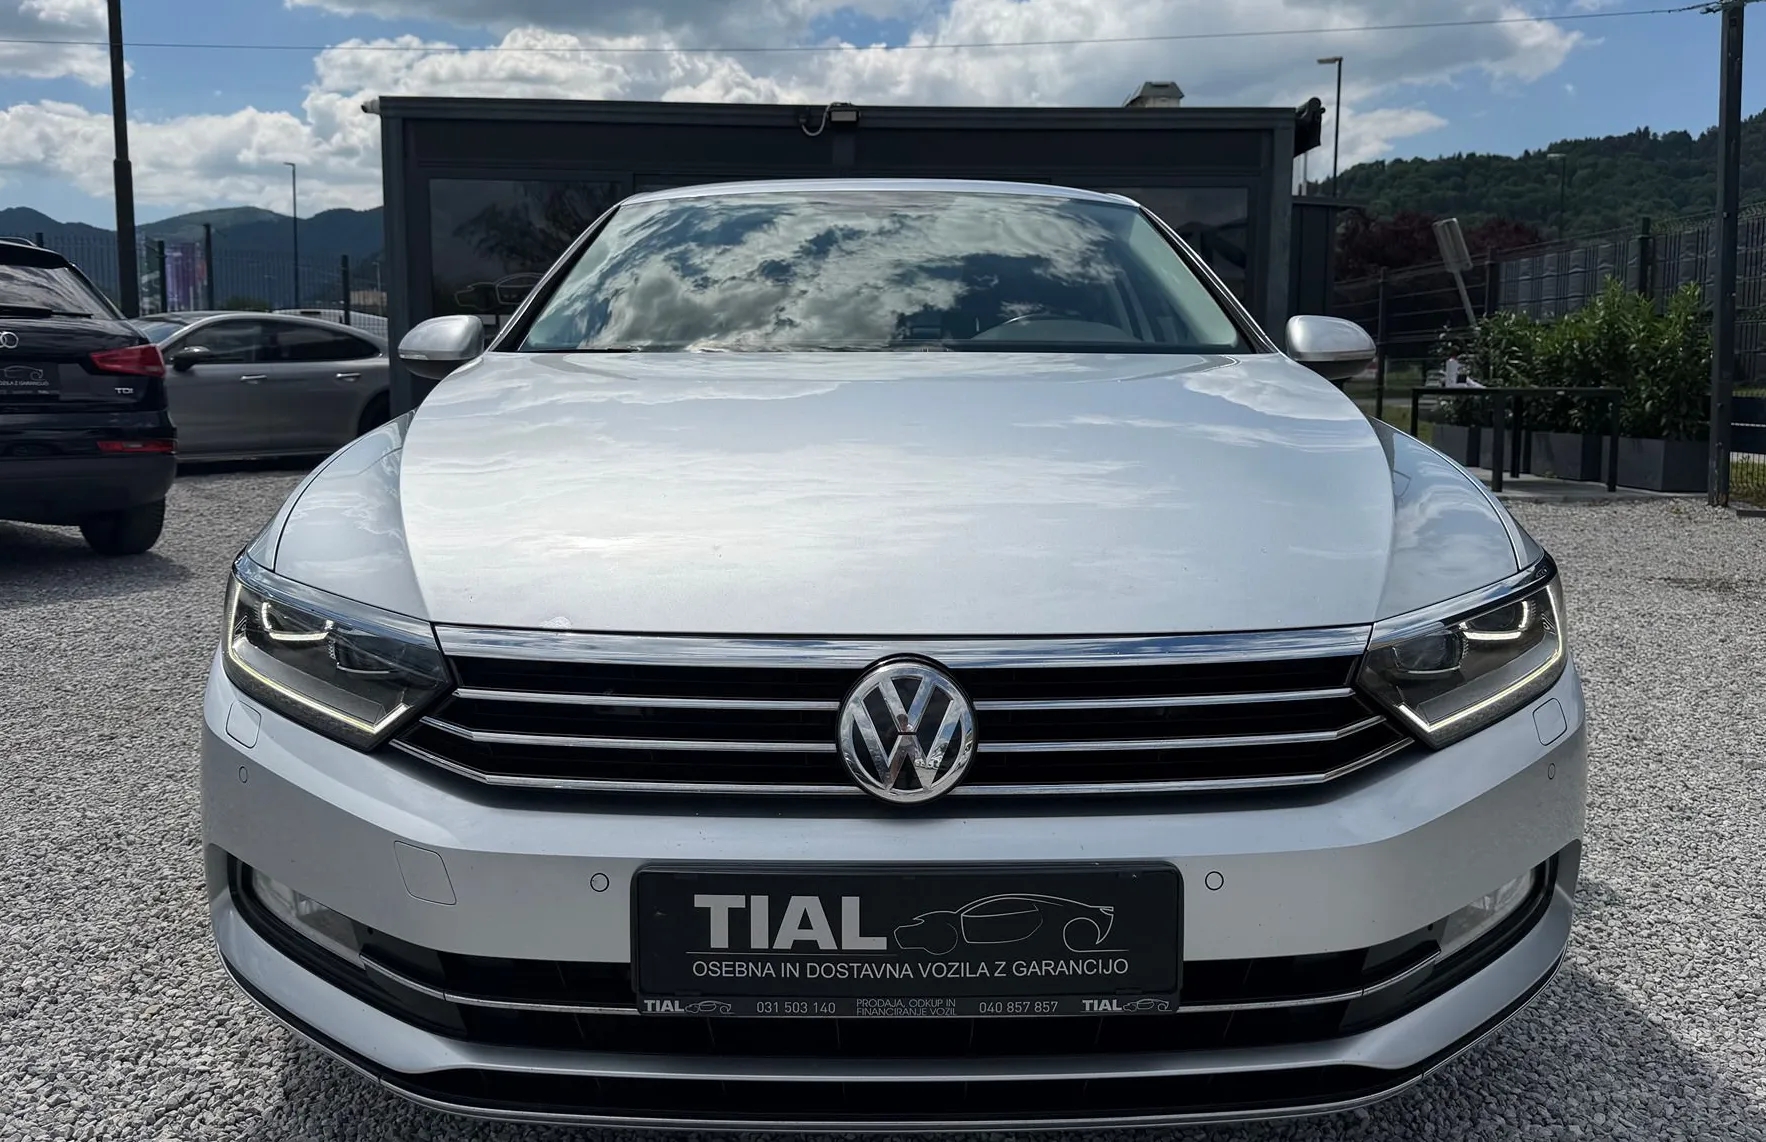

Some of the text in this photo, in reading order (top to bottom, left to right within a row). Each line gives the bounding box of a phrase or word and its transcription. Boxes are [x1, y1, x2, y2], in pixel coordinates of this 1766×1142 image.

[694, 894, 887, 950] TIAL
[692, 958, 1129, 979] OSEBNA IN DOSTAVNA VOZILA Z GARANCIJO
[643, 1000, 684, 1012] TIAL
[756, 1001, 836, 1014] 031 503 140
[856, 998, 956, 1008] PRODAJA, ODKUP IN
[979, 1001, 1059, 1013] 040 857 857
[1082, 999, 1122, 1011] TIAL
[856, 1007, 957, 1016] FINANCIRANJE VOZIL
